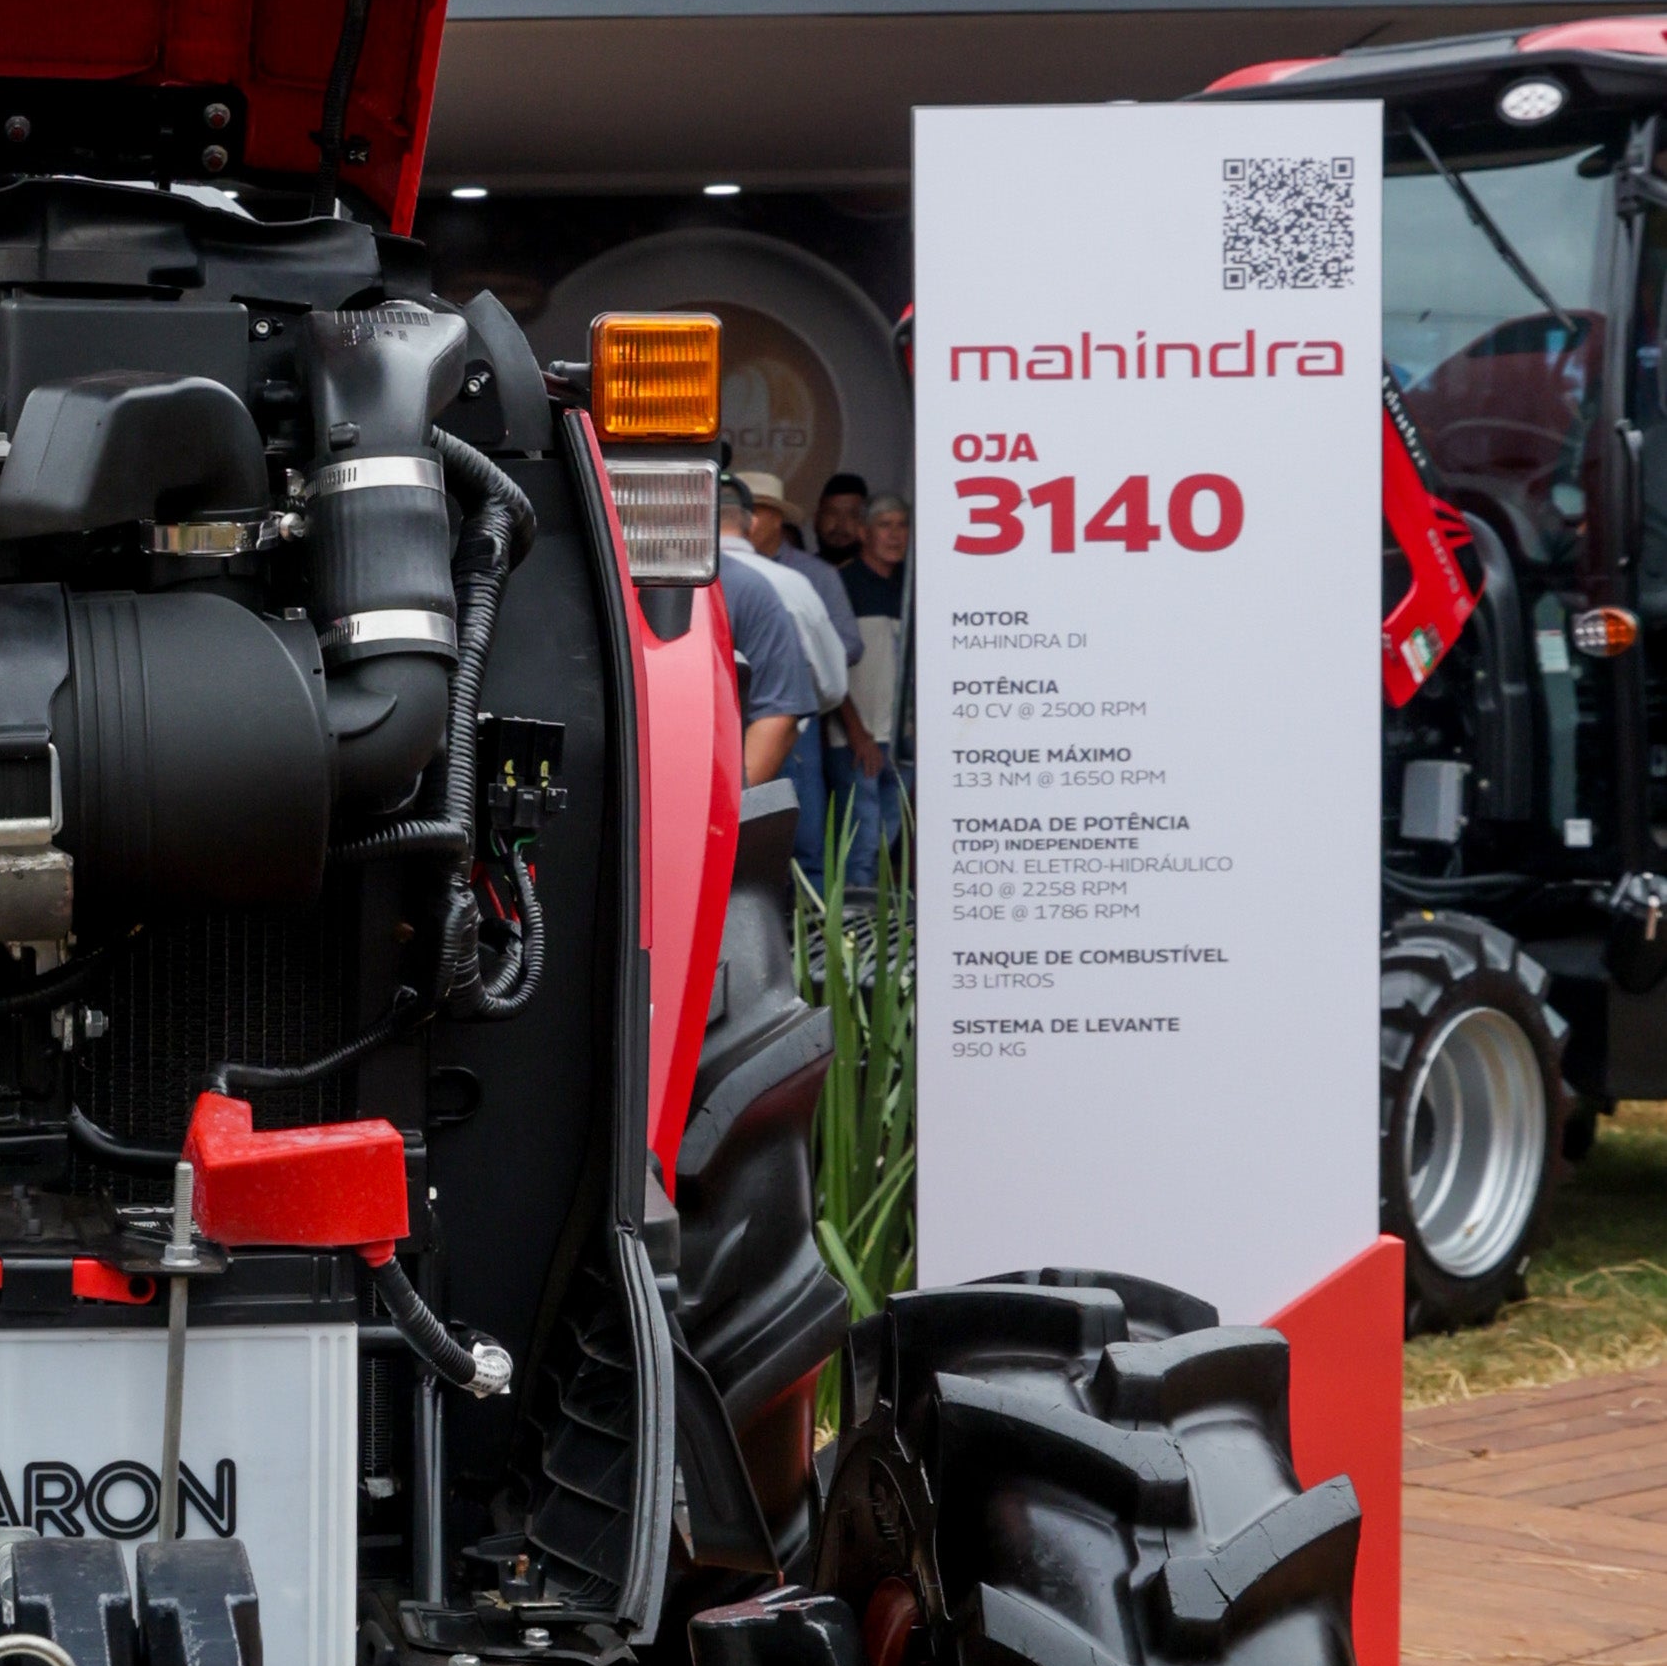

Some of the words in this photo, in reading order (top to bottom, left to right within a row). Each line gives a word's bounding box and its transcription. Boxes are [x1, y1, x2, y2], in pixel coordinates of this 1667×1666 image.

[950, 330, 1344, 381] mahindra
[952, 433, 1038, 462] OJA
[953, 473, 1244, 556] 3140
[952, 610, 1029, 627] MOTOR
[951, 633, 1063, 650] MAHINDRA
[1067, 632, 1088, 649] DI
[952, 675, 1060, 696] POTÊNCIA
[951, 702, 980, 719] 40
[984, 702, 1013, 719] CV
[1017, 701, 1035, 721] @
[1040, 701, 1096, 718] 2500
[1100, 700, 1147, 717] RPM
[951, 748, 1041, 768] TORQUE
[1046, 744, 1132, 763] MÁXIMO
[952, 771, 993, 788] 133
[999, 771, 1031, 787] NM
[1036, 770, 1055, 789] @
[1059, 769, 1115, 787] 1650
[1120, 769, 1166, 786] RPM
[951, 817, 1043, 834] TOMADA
[1048, 816, 1077, 833] DE
[1083, 811, 1190, 832] POTÊNCIA
[952, 838, 1000, 855] (TDP)
[1004, 837, 1139, 852] INDEPENDENTE
[951, 858, 1019, 875] ACION.
[1023, 853, 1234, 875] ELETRO-HIDRÁULICO
[952, 881, 994, 899] 540
[997, 881, 1016, 900] @
[1022, 880, 1077, 898] 2258
[1081, 880, 1127, 896] RPM
[952, 904, 1006, 921] 540E
[1011, 904, 1029, 922] @
[1034, 903, 1089, 920] 1786
[1094, 902, 1140, 919] RPM
[952, 950, 1039, 969] TANQUE
[1044, 949, 1073, 966] DE
[1078, 944, 1229, 965] COMBUSTÍVEL
[951, 973, 978, 990] 33
[983, 972, 1055, 990] LITROS
[952, 1018, 1045, 1035] SISTEMA
[1050, 1018, 1079, 1034] DE
[1085, 1016, 1180, 1033] LEVANTE
[951, 1041, 994, 1058] 950
[998, 1041, 1027, 1058] KG
